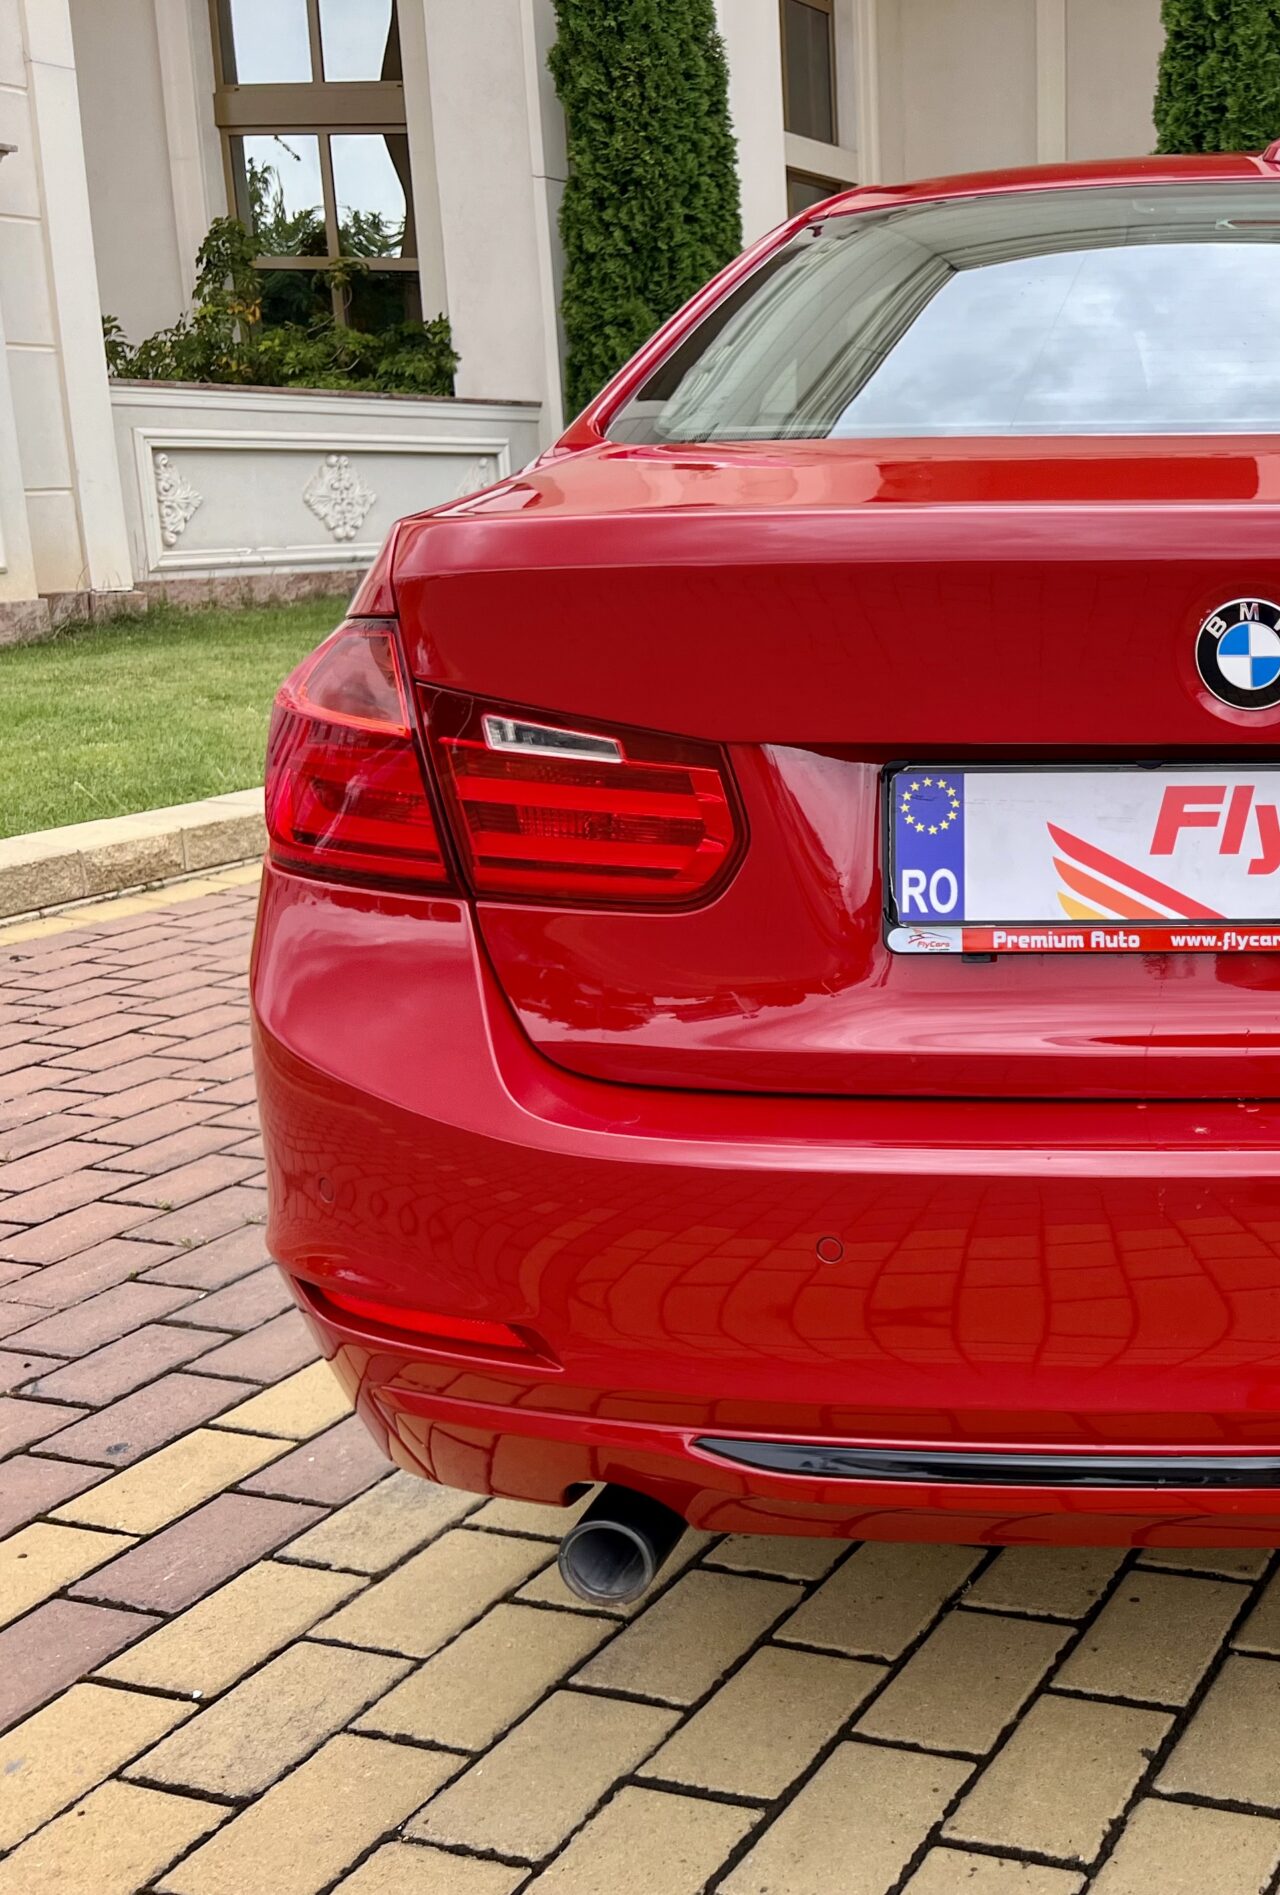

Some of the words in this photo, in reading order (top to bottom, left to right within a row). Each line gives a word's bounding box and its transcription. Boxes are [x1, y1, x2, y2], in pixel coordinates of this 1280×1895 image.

[902, 868, 958, 914] RO
[992, 932, 1085, 949] Premium
[1090, 931, 1140, 948] Auto
